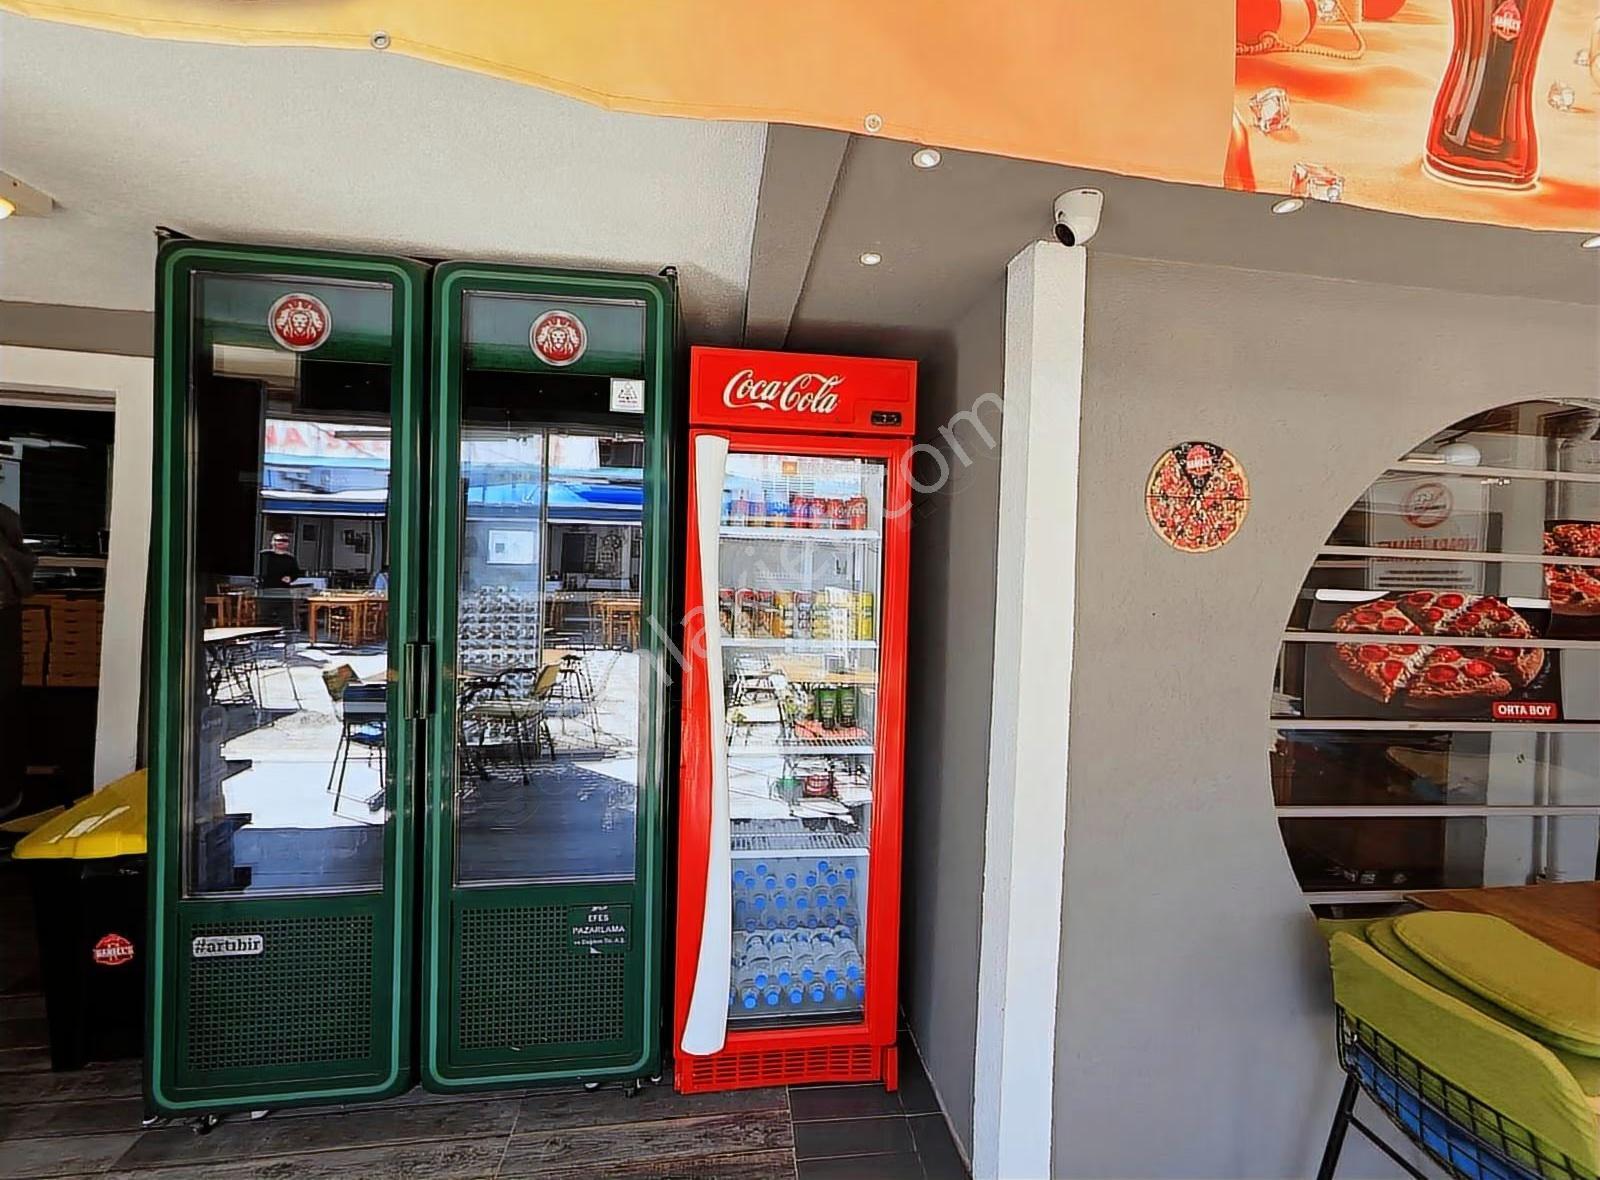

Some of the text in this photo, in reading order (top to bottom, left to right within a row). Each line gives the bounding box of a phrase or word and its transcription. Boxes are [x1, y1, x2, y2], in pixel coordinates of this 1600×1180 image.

[723, 369, 846, 414] Coca-Cola
[1498, 704, 1552, 716] ORTA BOY
[588, 914, 609, 922] EFES
[572, 925, 625, 935] PAZARLAMA
